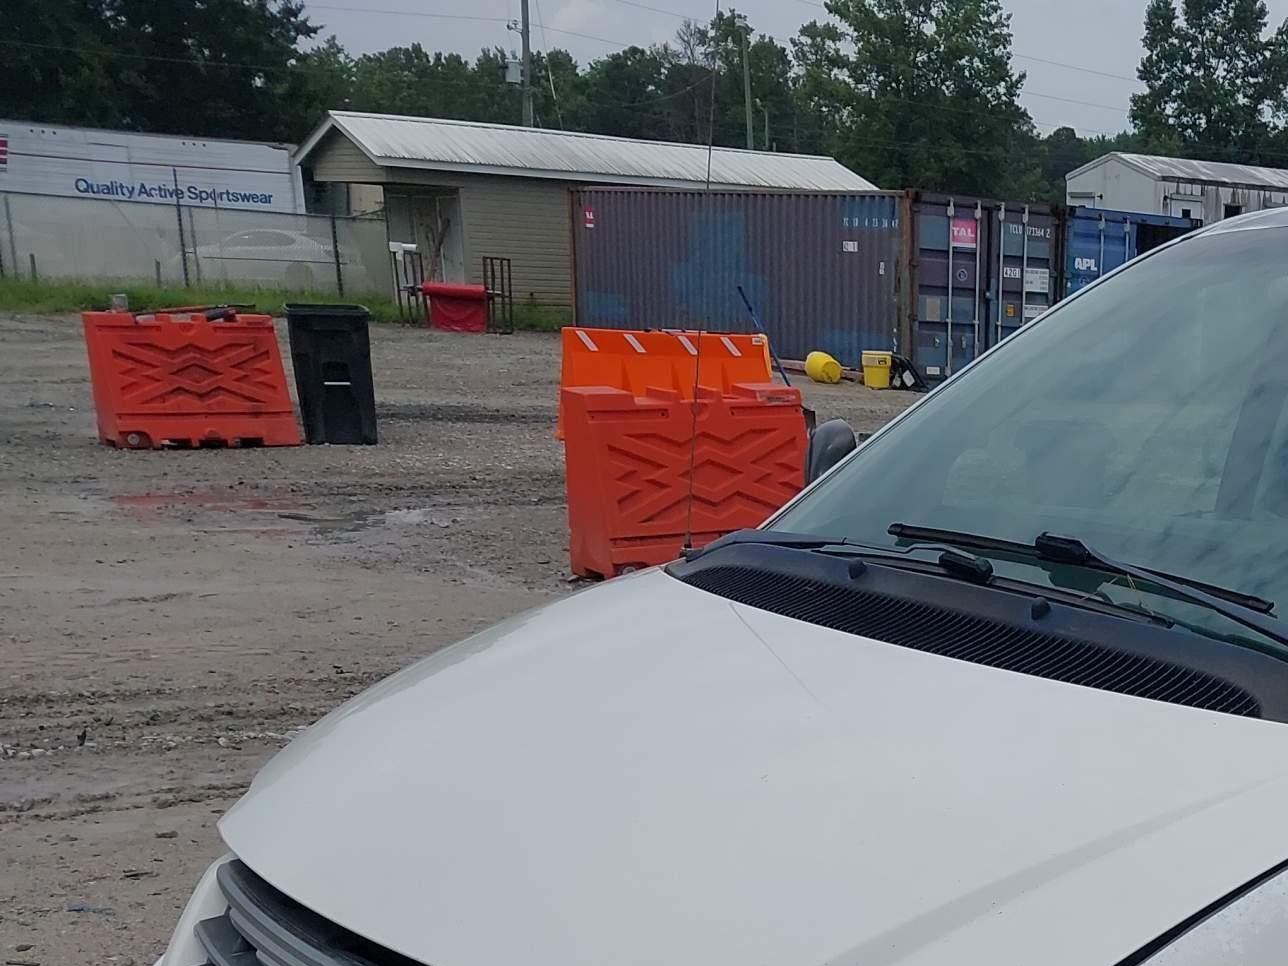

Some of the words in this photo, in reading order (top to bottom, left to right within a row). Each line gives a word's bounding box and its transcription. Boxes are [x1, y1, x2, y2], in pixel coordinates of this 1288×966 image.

[75, 178, 135, 199] Quality
[138, 183, 184, 199] Active
[187, 186, 272, 205] Sportswear
[952, 226, 976, 237] TAL
[1074, 256, 1098, 271] APL
